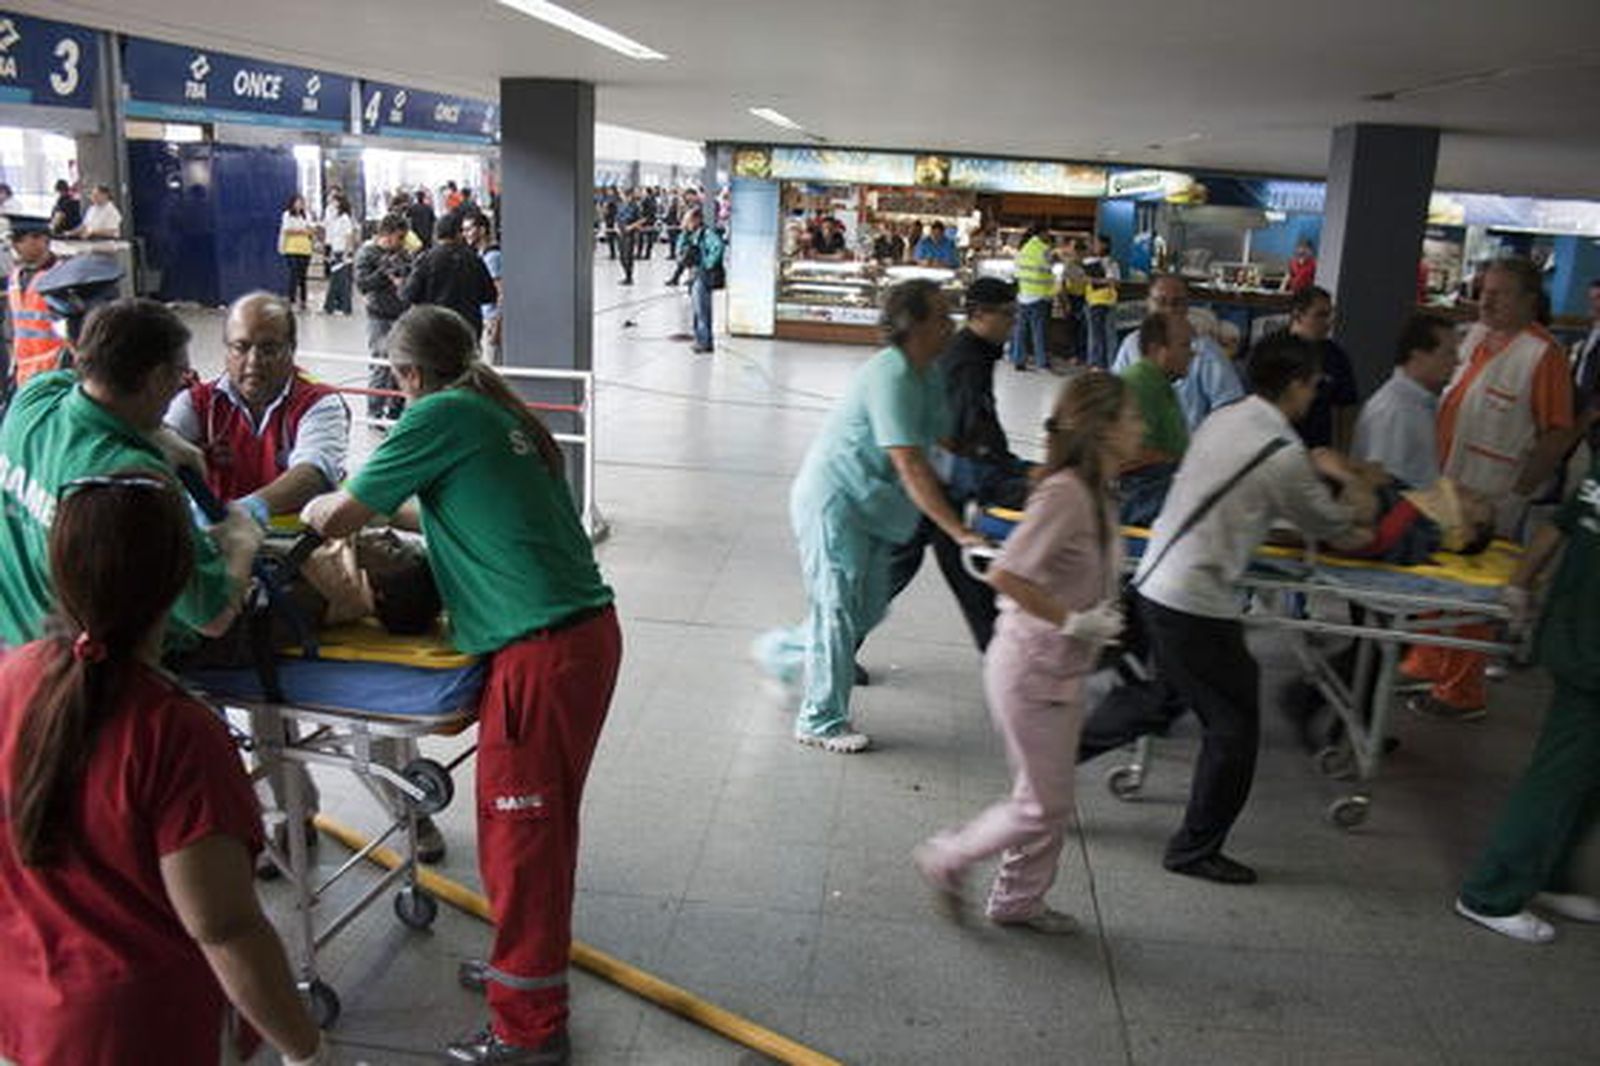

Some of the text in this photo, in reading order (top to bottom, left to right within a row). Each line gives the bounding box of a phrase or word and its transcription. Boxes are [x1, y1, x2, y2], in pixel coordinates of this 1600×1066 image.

[50, 38, 79, 95] 3
[233, 69, 283, 99] ONCE
[364, 90, 382, 127] 4
